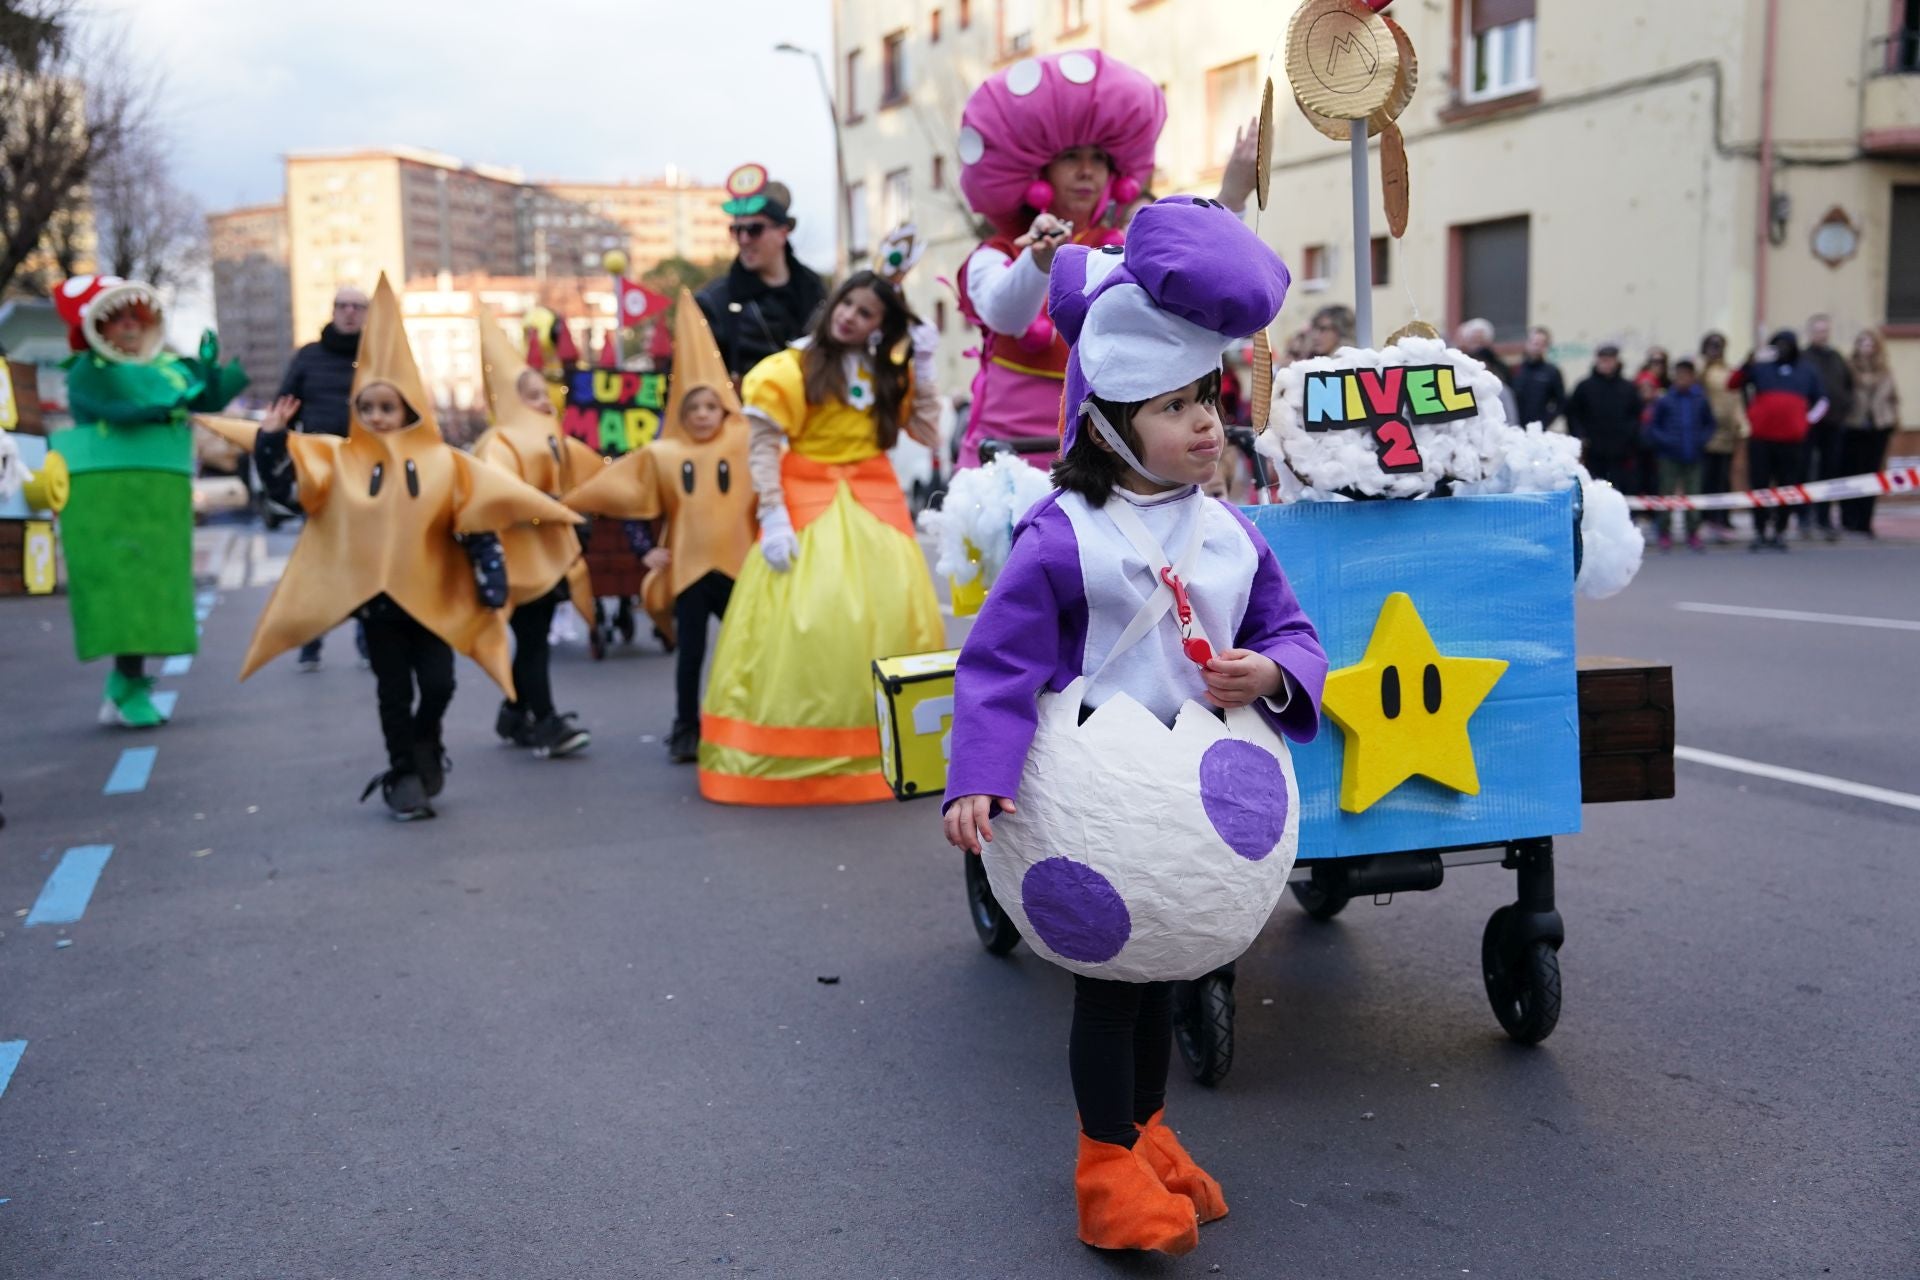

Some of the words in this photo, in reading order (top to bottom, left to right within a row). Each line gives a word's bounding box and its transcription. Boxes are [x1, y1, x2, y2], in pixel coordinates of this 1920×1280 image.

[1306, 366, 1477, 426] NIVEL
[562, 404, 665, 454] MAR
[1375, 419, 1421, 469] 2
